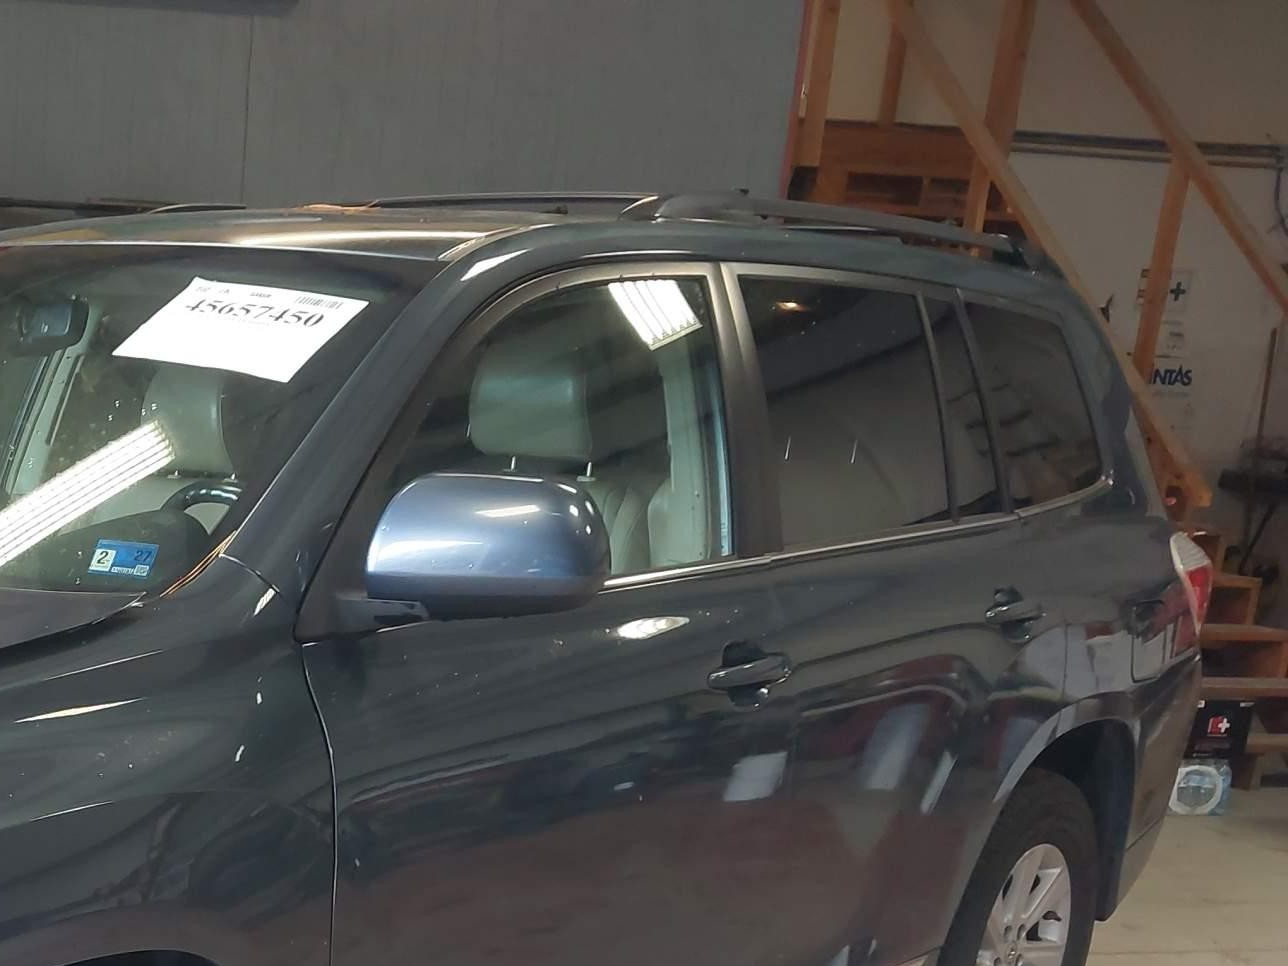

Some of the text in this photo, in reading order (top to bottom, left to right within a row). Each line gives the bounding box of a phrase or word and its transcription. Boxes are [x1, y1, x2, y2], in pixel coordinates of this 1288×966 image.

[186, 299, 324, 327] 45657450
[1148, 364, 1192, 386] INTAS
[97, 550, 109, 565] 2
